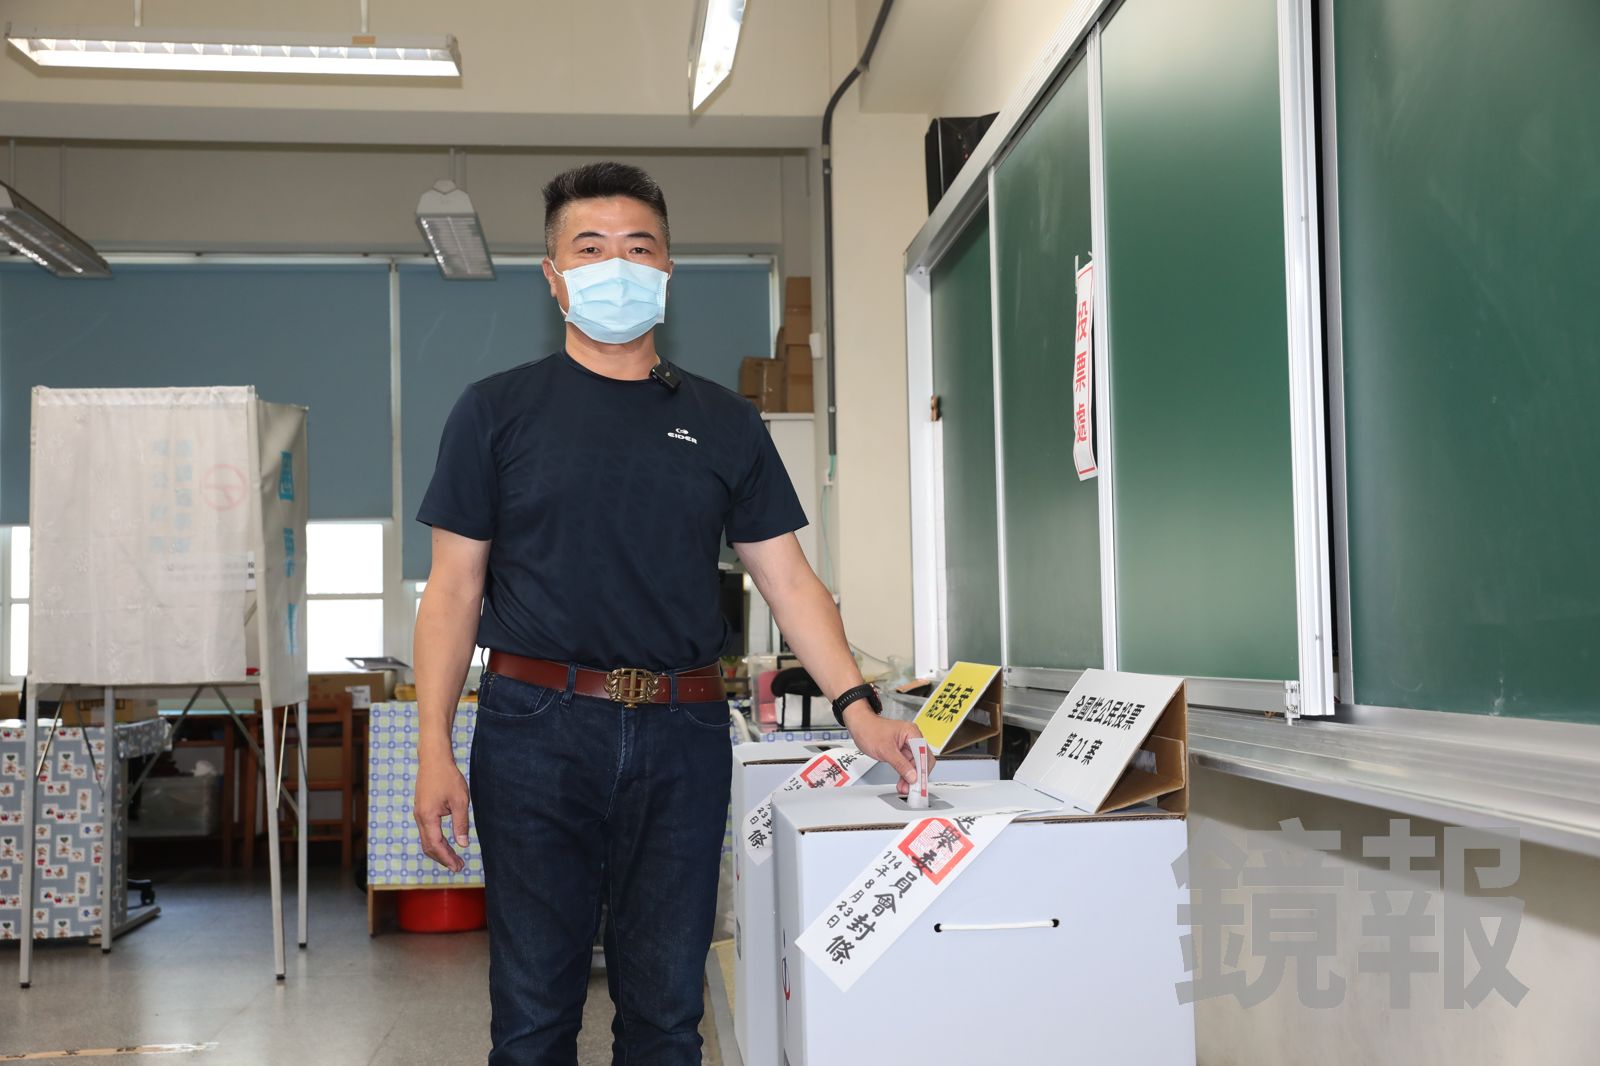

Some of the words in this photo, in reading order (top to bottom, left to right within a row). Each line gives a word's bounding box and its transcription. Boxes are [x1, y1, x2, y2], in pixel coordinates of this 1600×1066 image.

[1067, 695, 1146, 731] 全國性公民投票
[1056, 732, 1103, 765] 第21案
